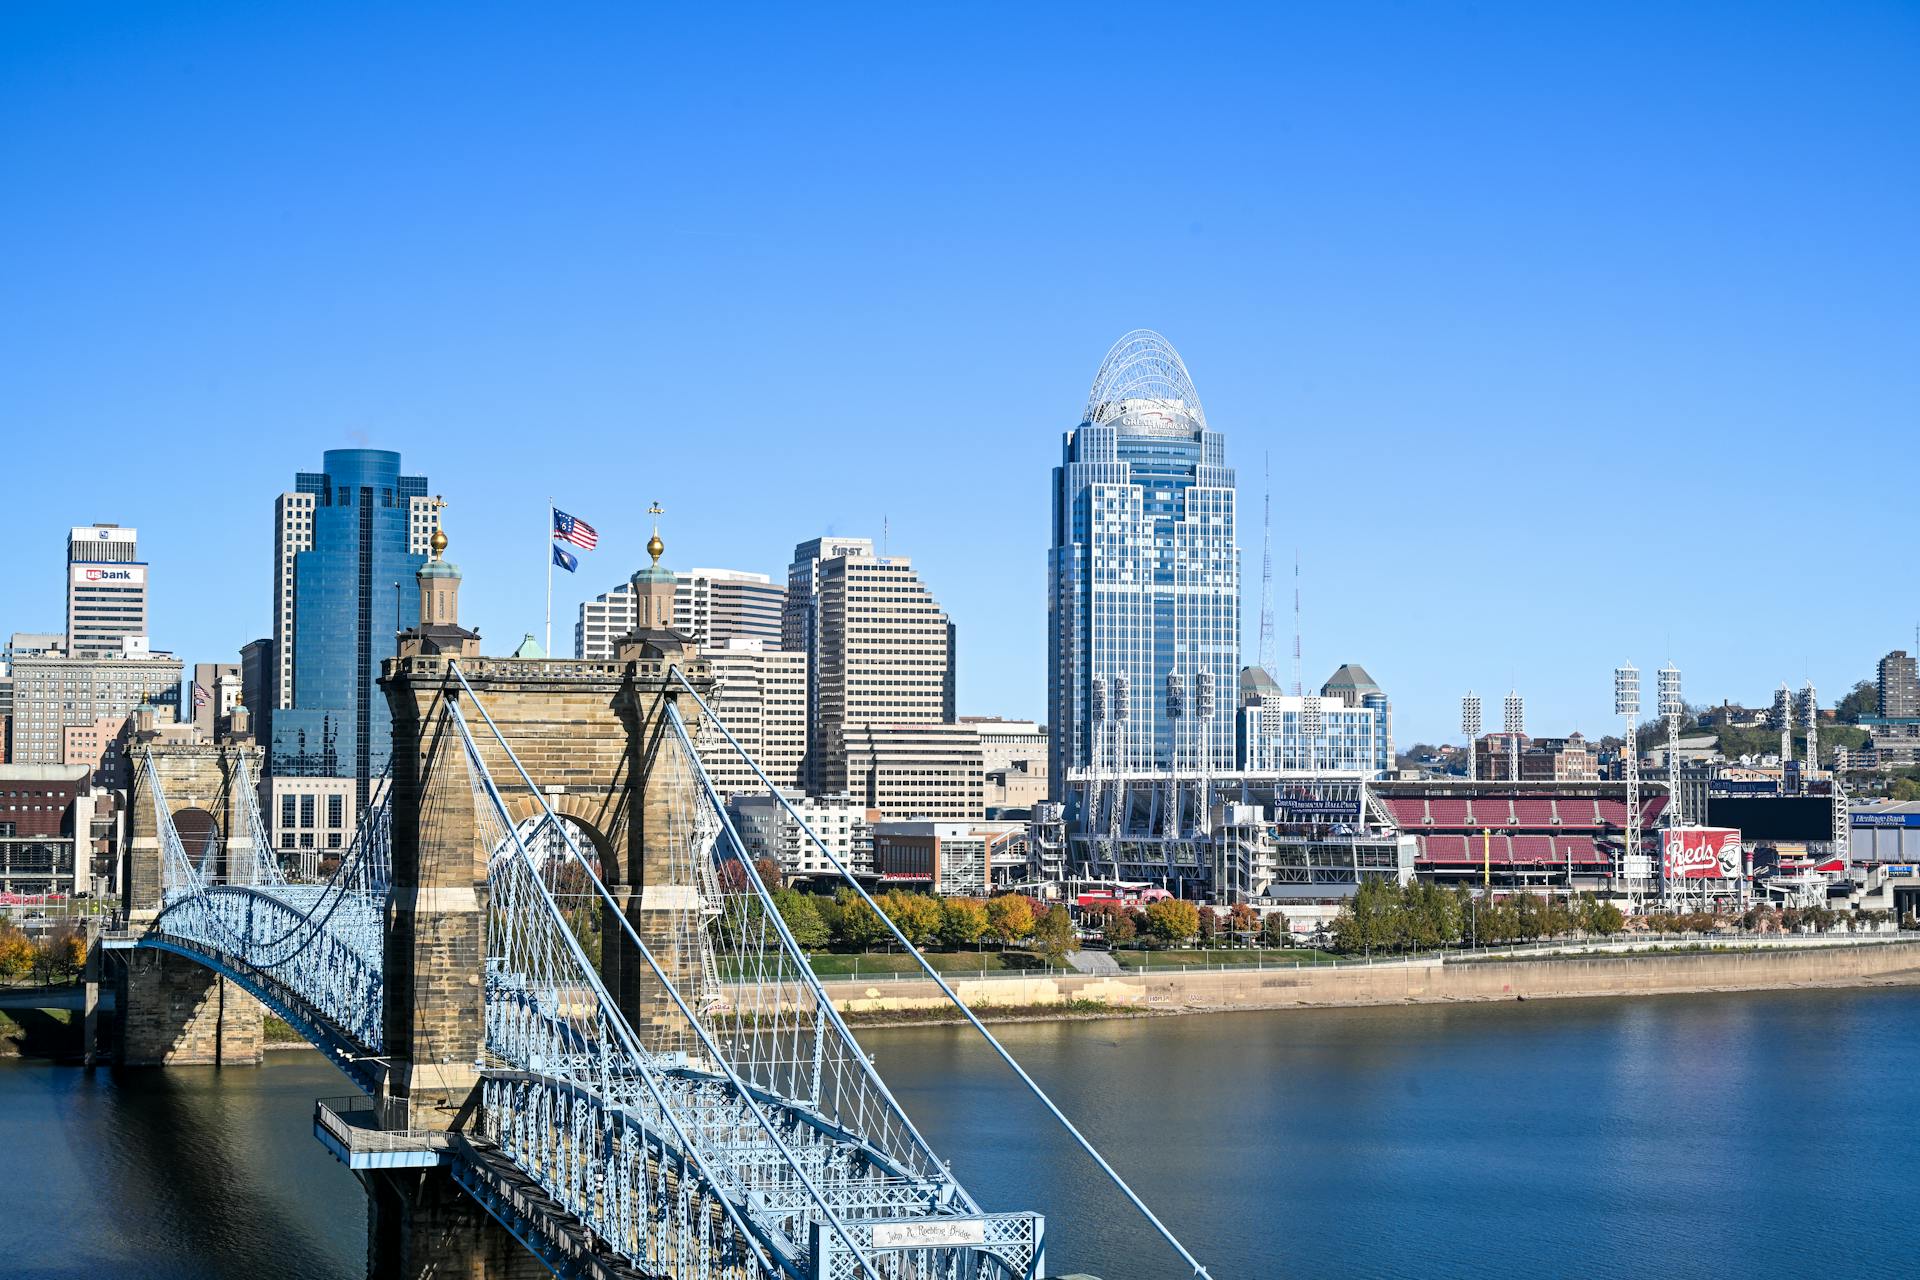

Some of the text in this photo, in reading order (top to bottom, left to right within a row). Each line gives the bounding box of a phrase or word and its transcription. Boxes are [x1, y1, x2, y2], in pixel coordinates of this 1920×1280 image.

[1122, 417, 1190, 431] GREAT AMERICAN
[1855, 815, 1886, 824] Heritage
[1886, 814, 1906, 823] Bank
[1665, 836, 1716, 875] Reds
[887, 1231, 903, 1244] John
[949, 1224, 971, 1240] Bridge
